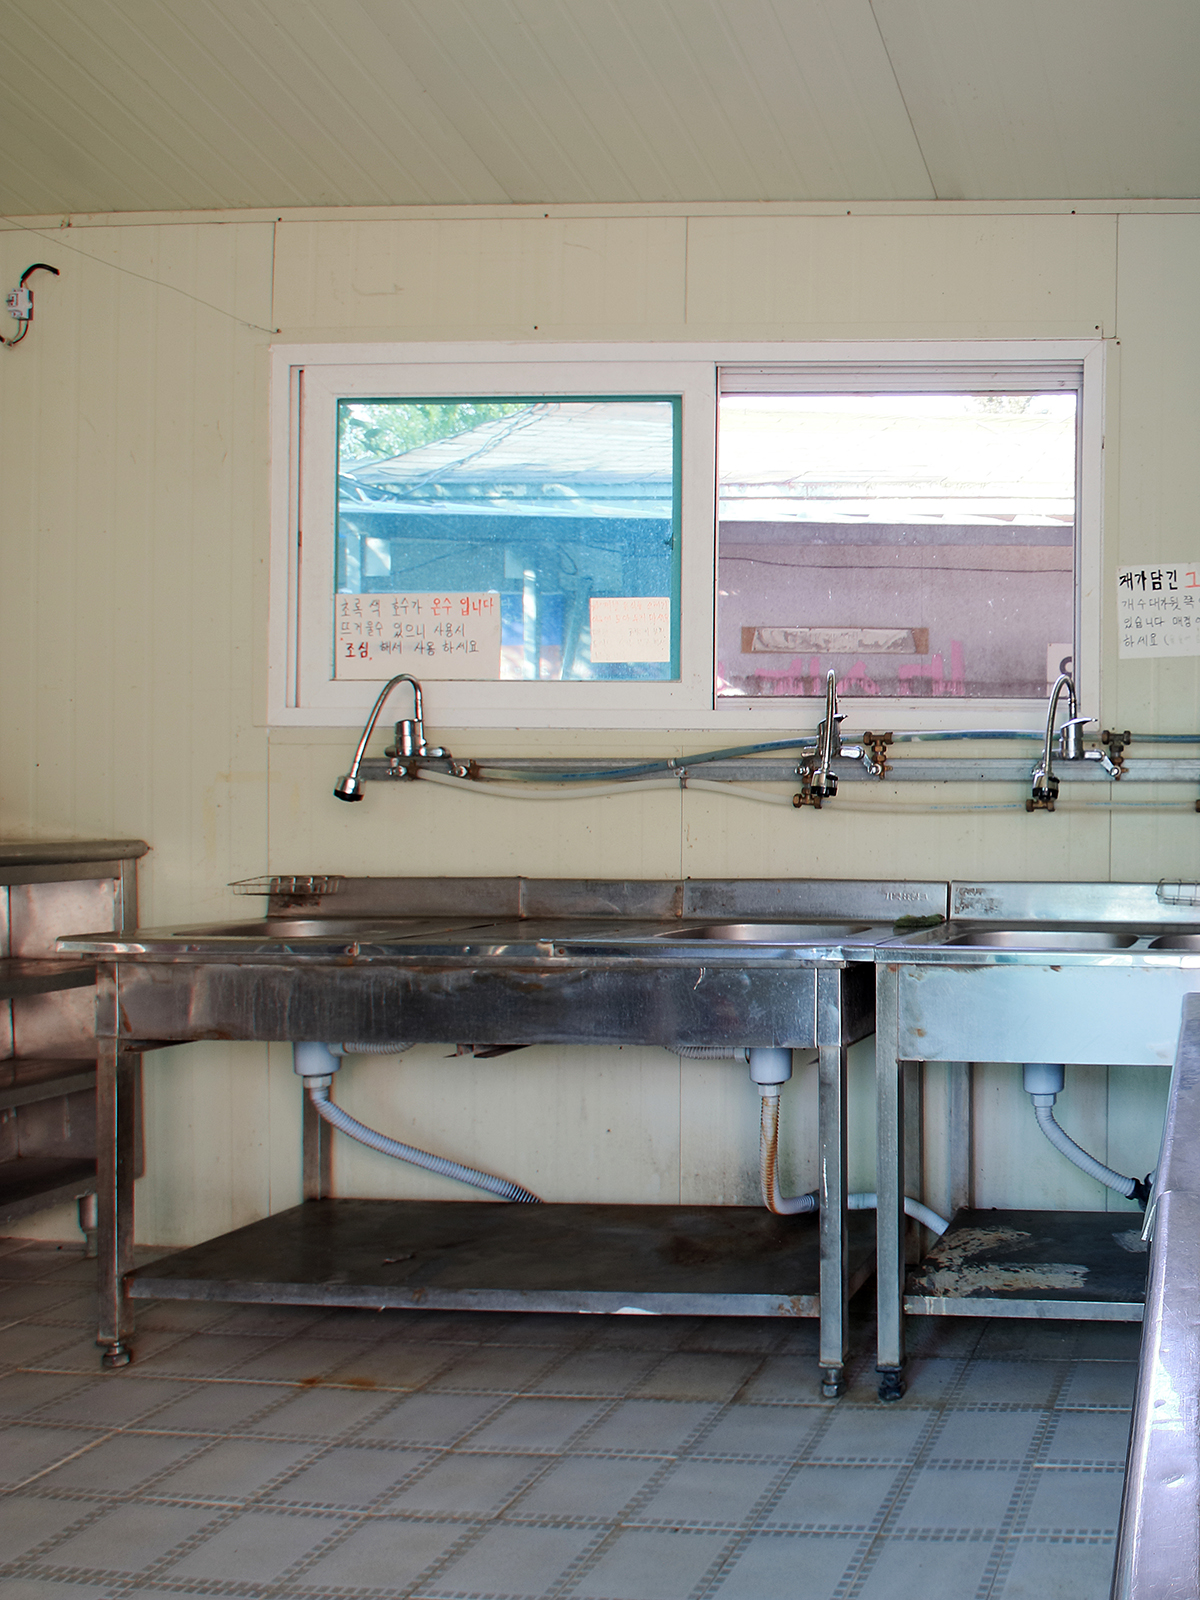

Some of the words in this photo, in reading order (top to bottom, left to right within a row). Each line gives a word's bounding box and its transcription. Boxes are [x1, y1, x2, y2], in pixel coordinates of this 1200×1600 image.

[459, 596, 494, 616] 입니다
[393, 622, 426, 638] 있으니
[433, 623, 466, 637] 사용시
[1123, 615, 1165, 629] 있습니다
[380, 641, 403, 654] 해서
[413, 641, 436, 656] 사용
[441, 639, 480, 654] 하세요
[1122, 632, 1159, 648] 하세요
